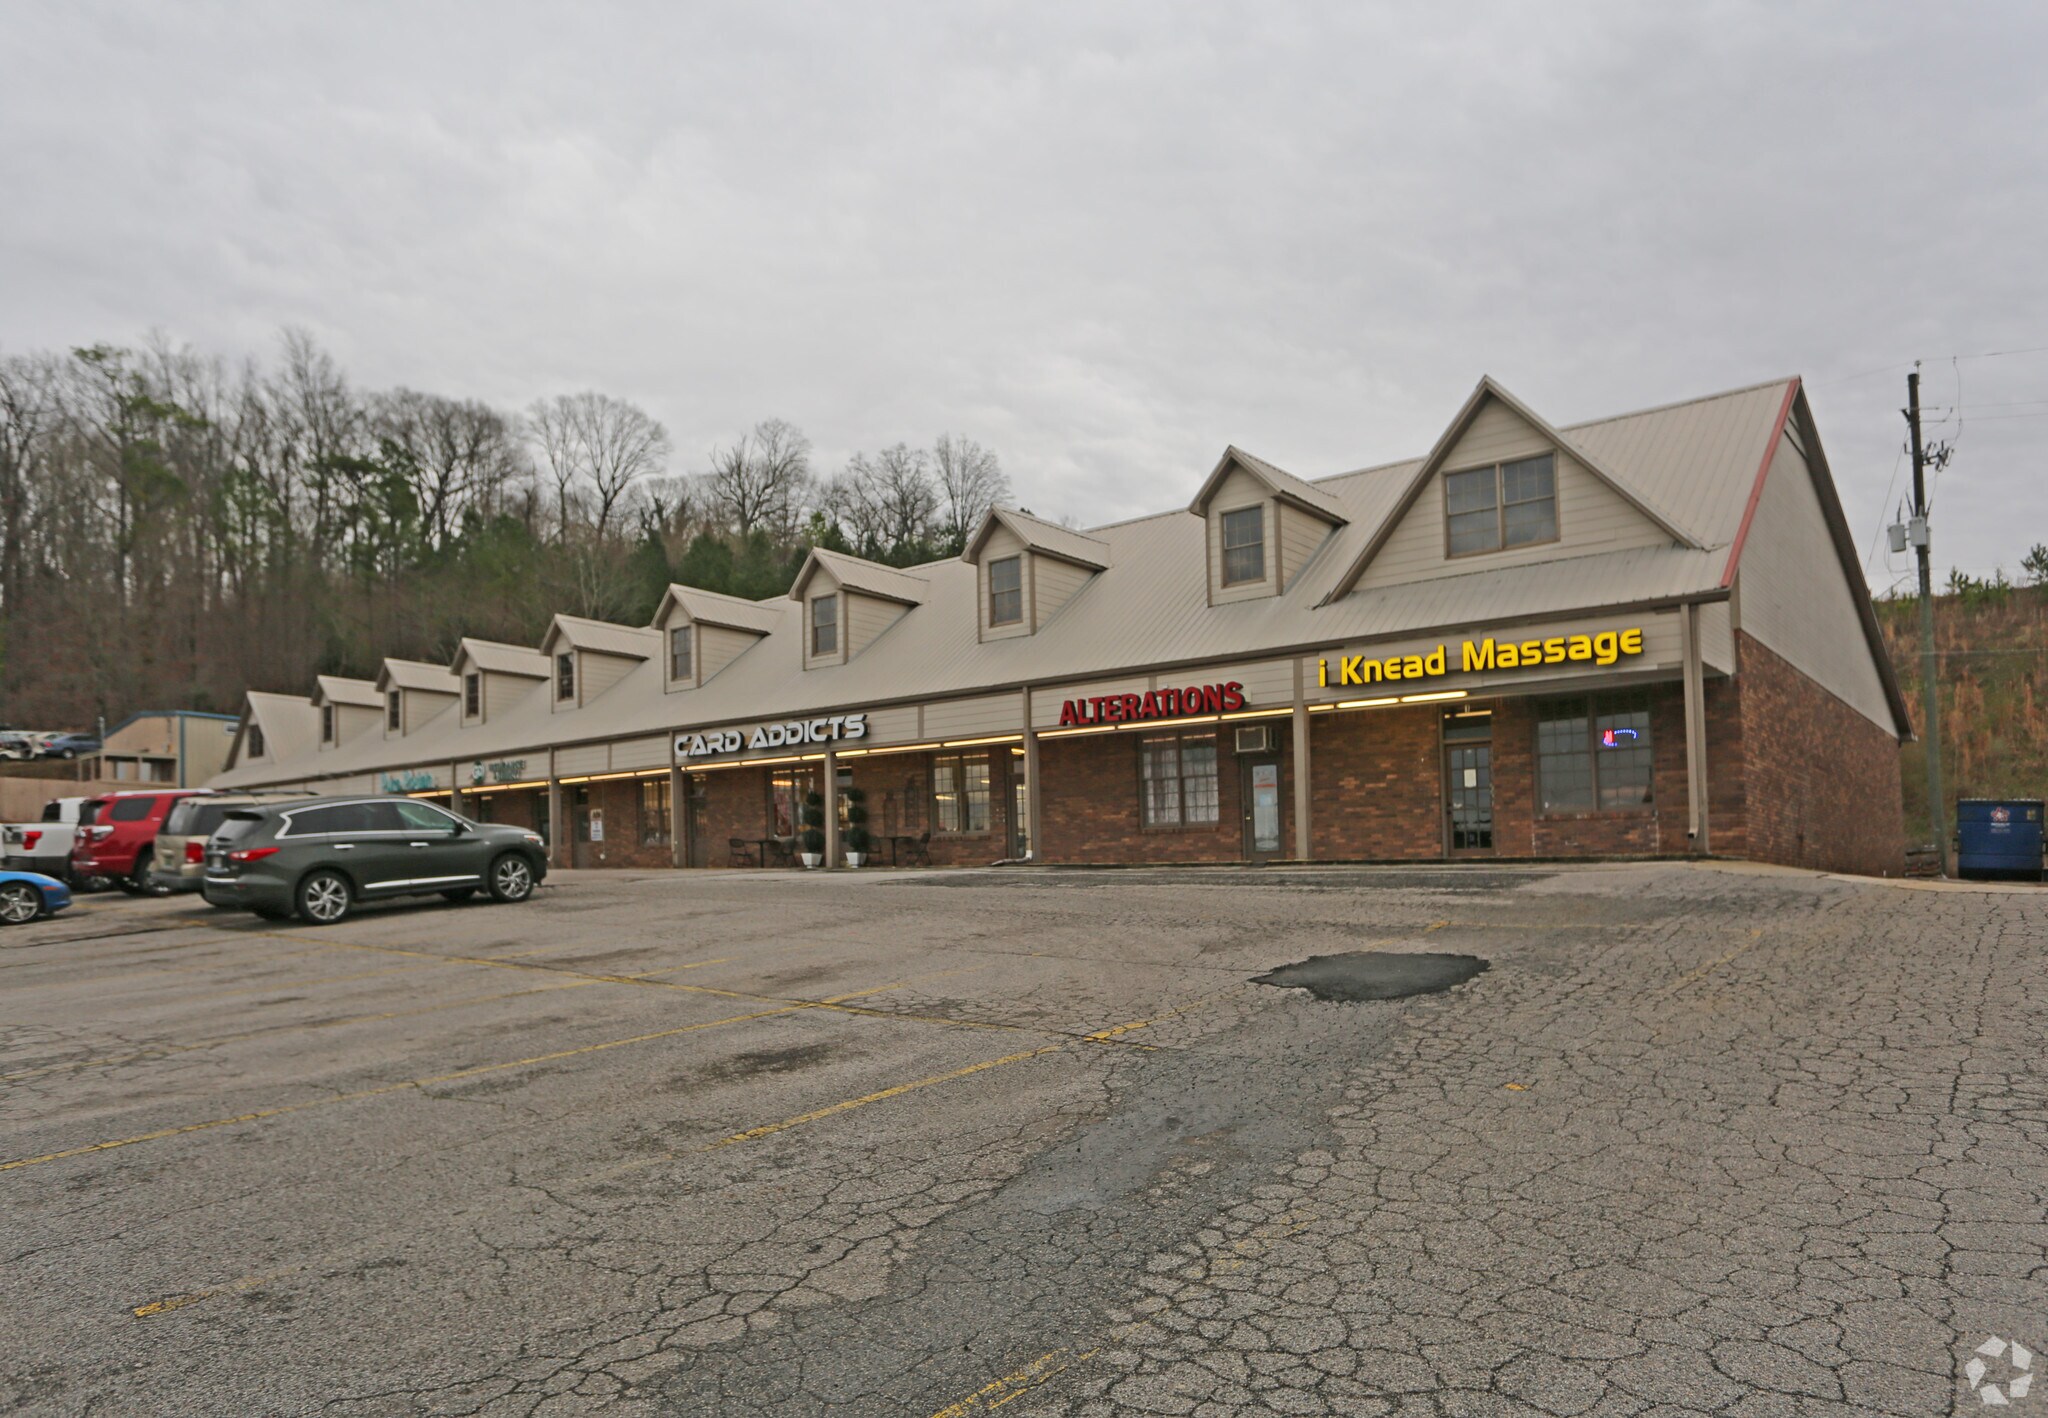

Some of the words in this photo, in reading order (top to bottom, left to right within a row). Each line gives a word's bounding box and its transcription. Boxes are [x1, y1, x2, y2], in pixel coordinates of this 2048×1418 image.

[1318, 659, 1326, 687] i
[1340, 645, 1446, 685] Knead
[1462, 628, 1643, 673] Massage
[1059, 681, 1244, 726] ALTERATIONS
[673, 730, 743, 756] CARD
[748, 714, 867, 750] ADDICTS
